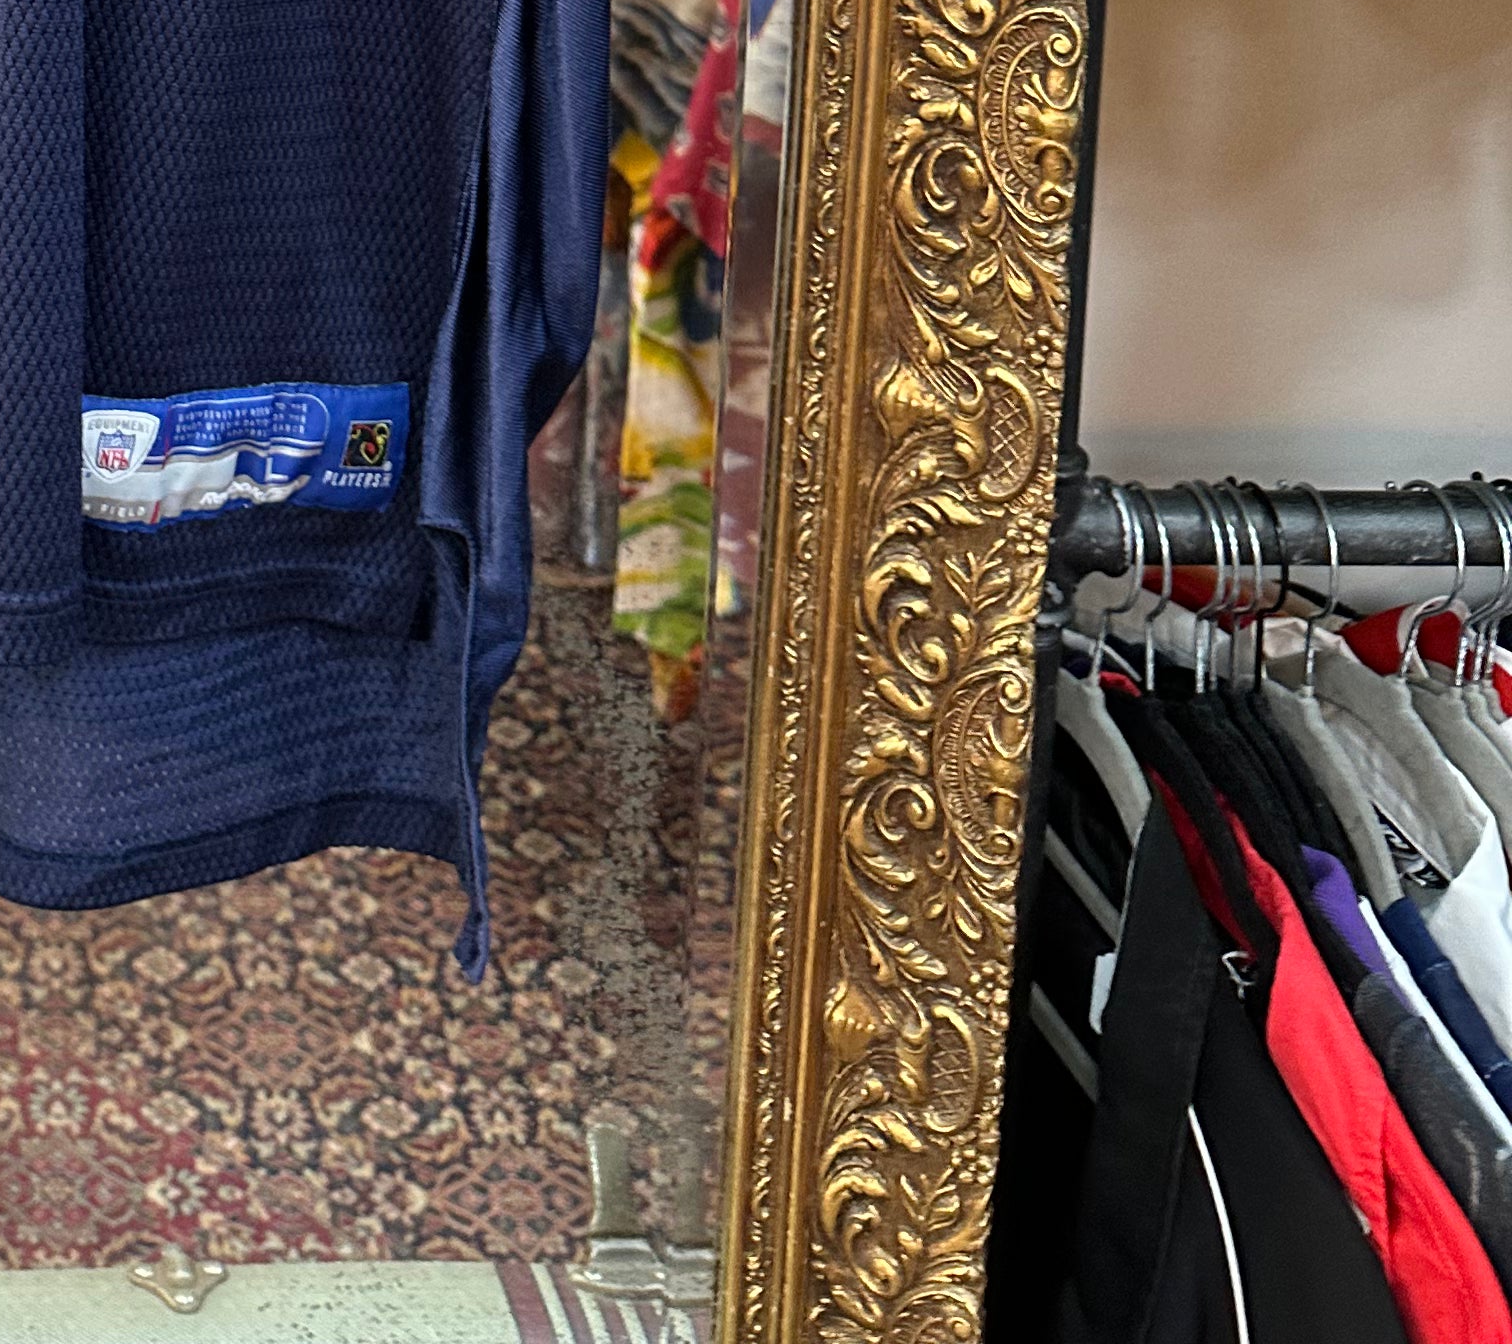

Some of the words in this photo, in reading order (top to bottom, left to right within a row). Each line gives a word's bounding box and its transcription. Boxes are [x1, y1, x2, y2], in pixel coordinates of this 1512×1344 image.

[88, 418, 151, 434] EQUIPMENT
[97, 450, 129, 471] NFL
[265, 457, 289, 482] L
[100, 503, 146, 518] FIELD
